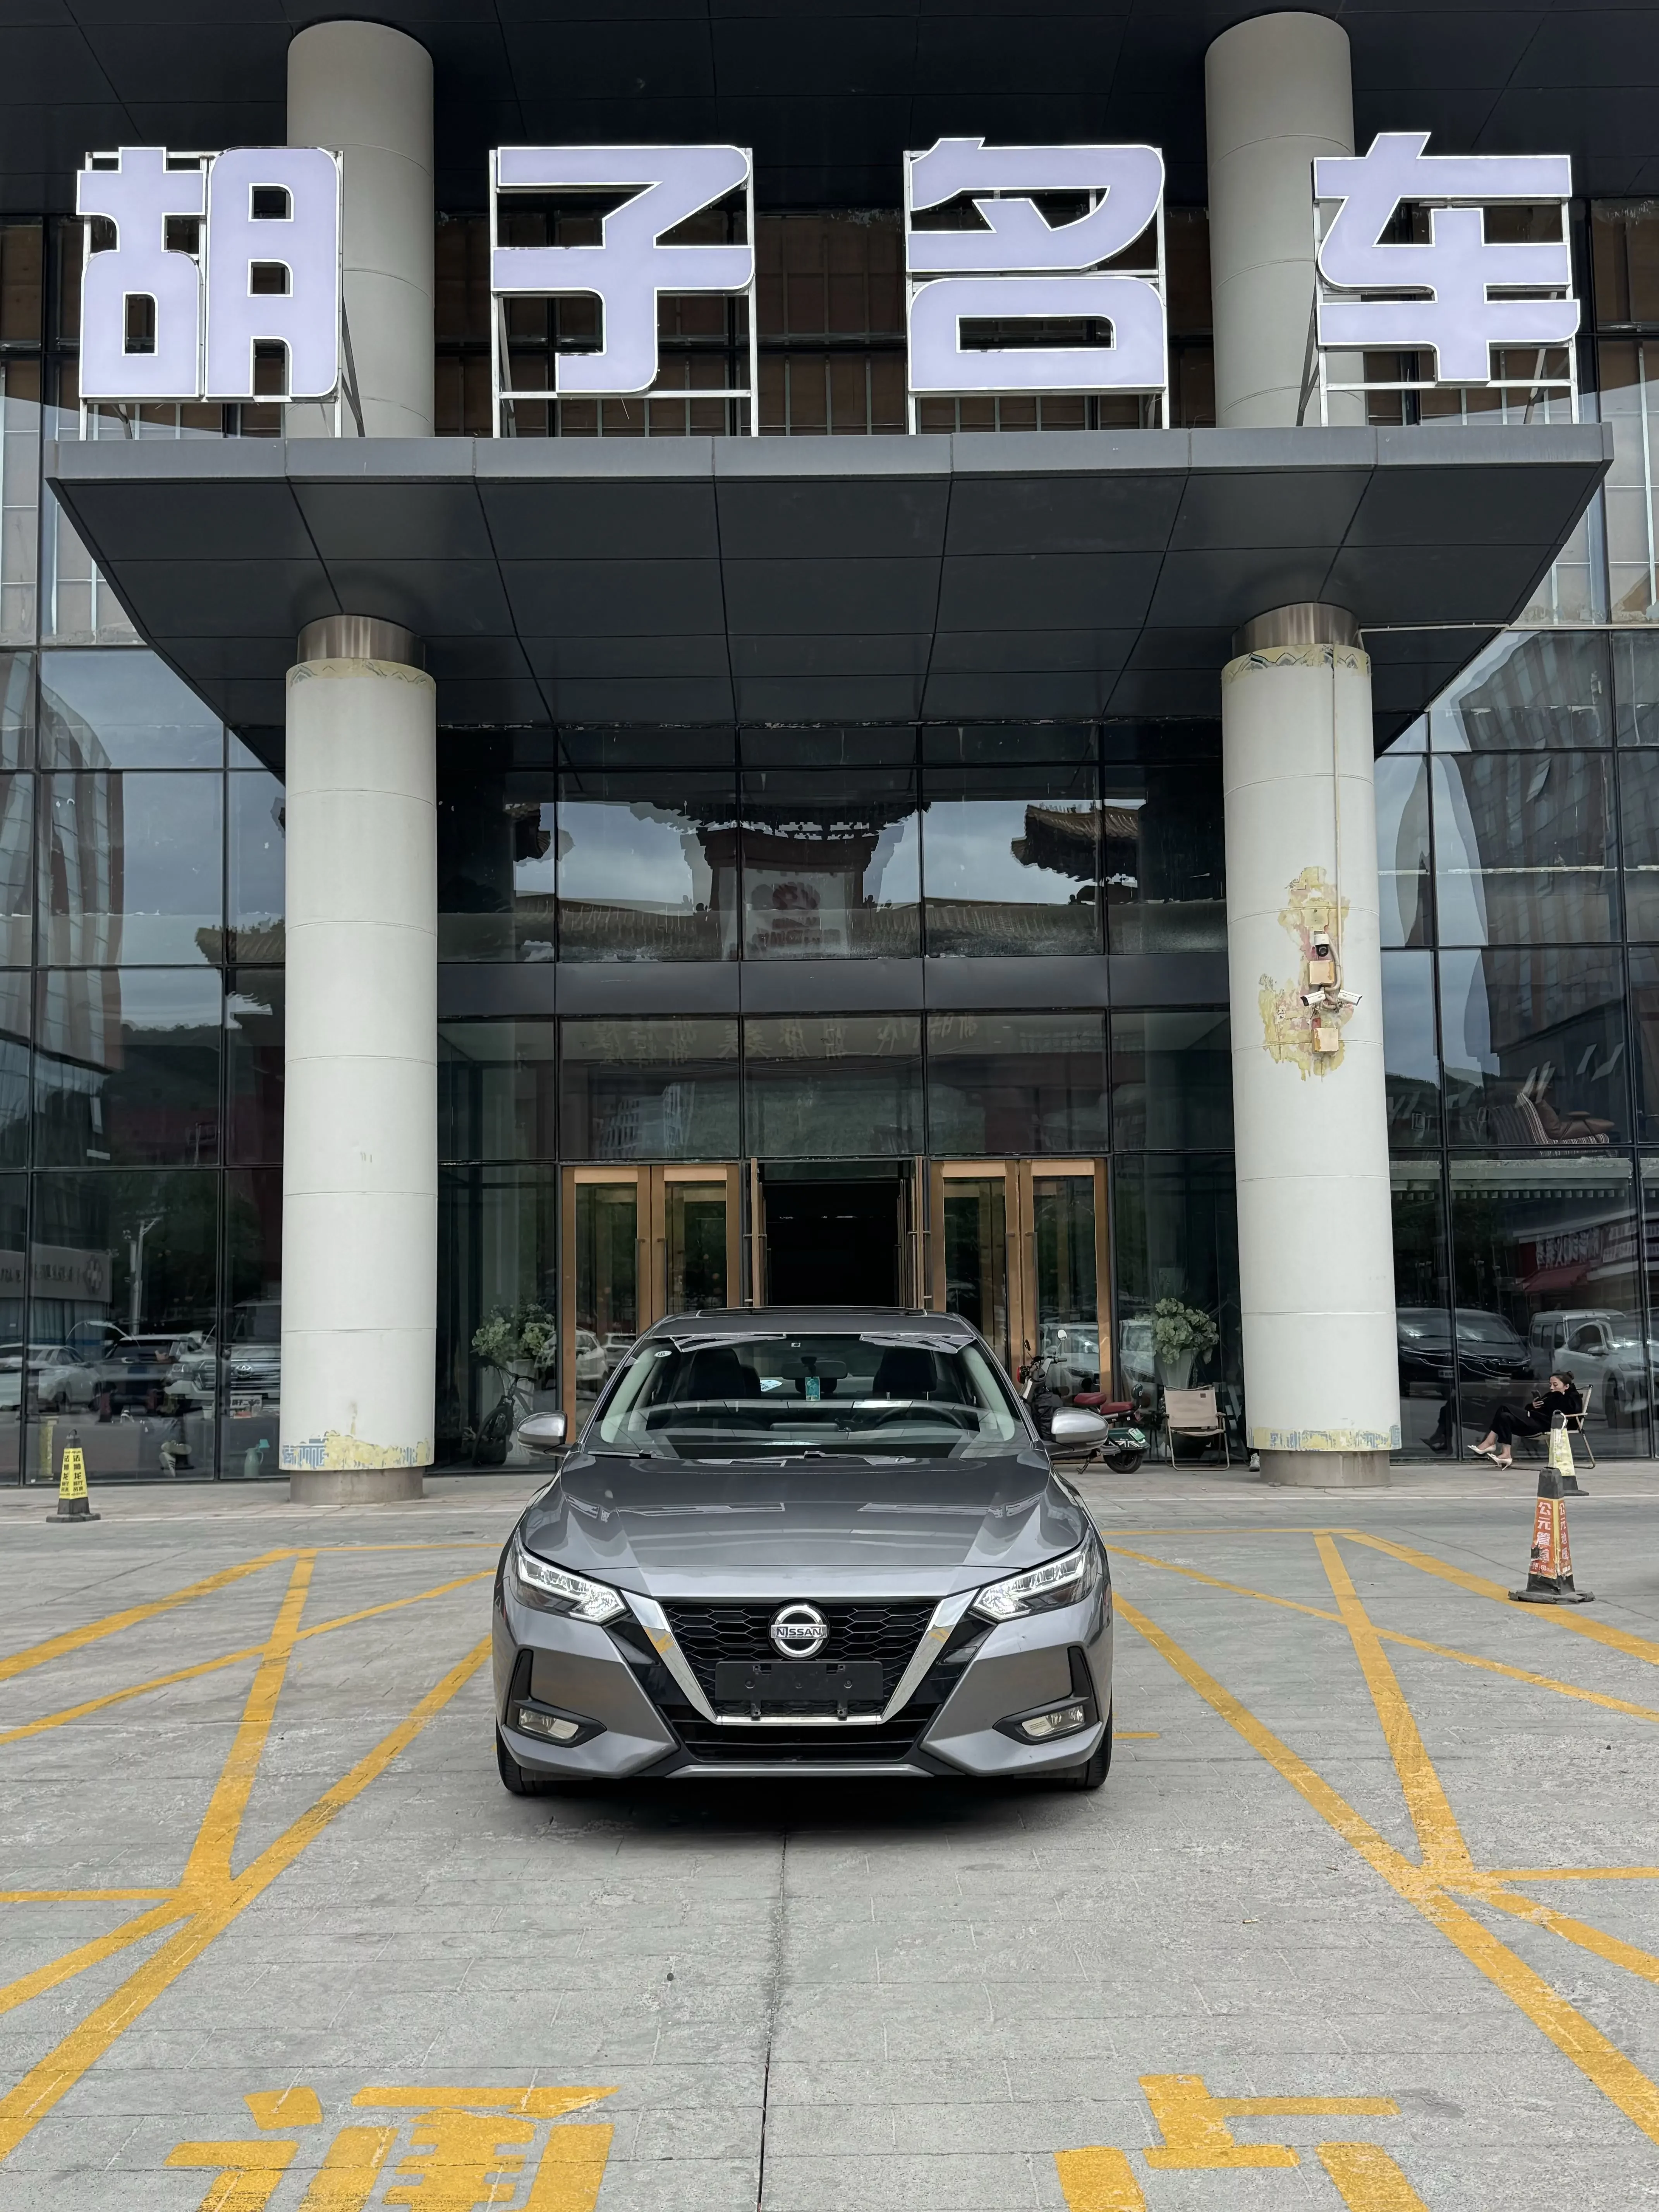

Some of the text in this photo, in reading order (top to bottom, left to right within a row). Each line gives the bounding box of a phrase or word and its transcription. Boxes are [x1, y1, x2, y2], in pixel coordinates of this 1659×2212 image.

[76, 132, 1581, 398] 胡子名车
[776, 1628, 821, 1636] NISSAN
